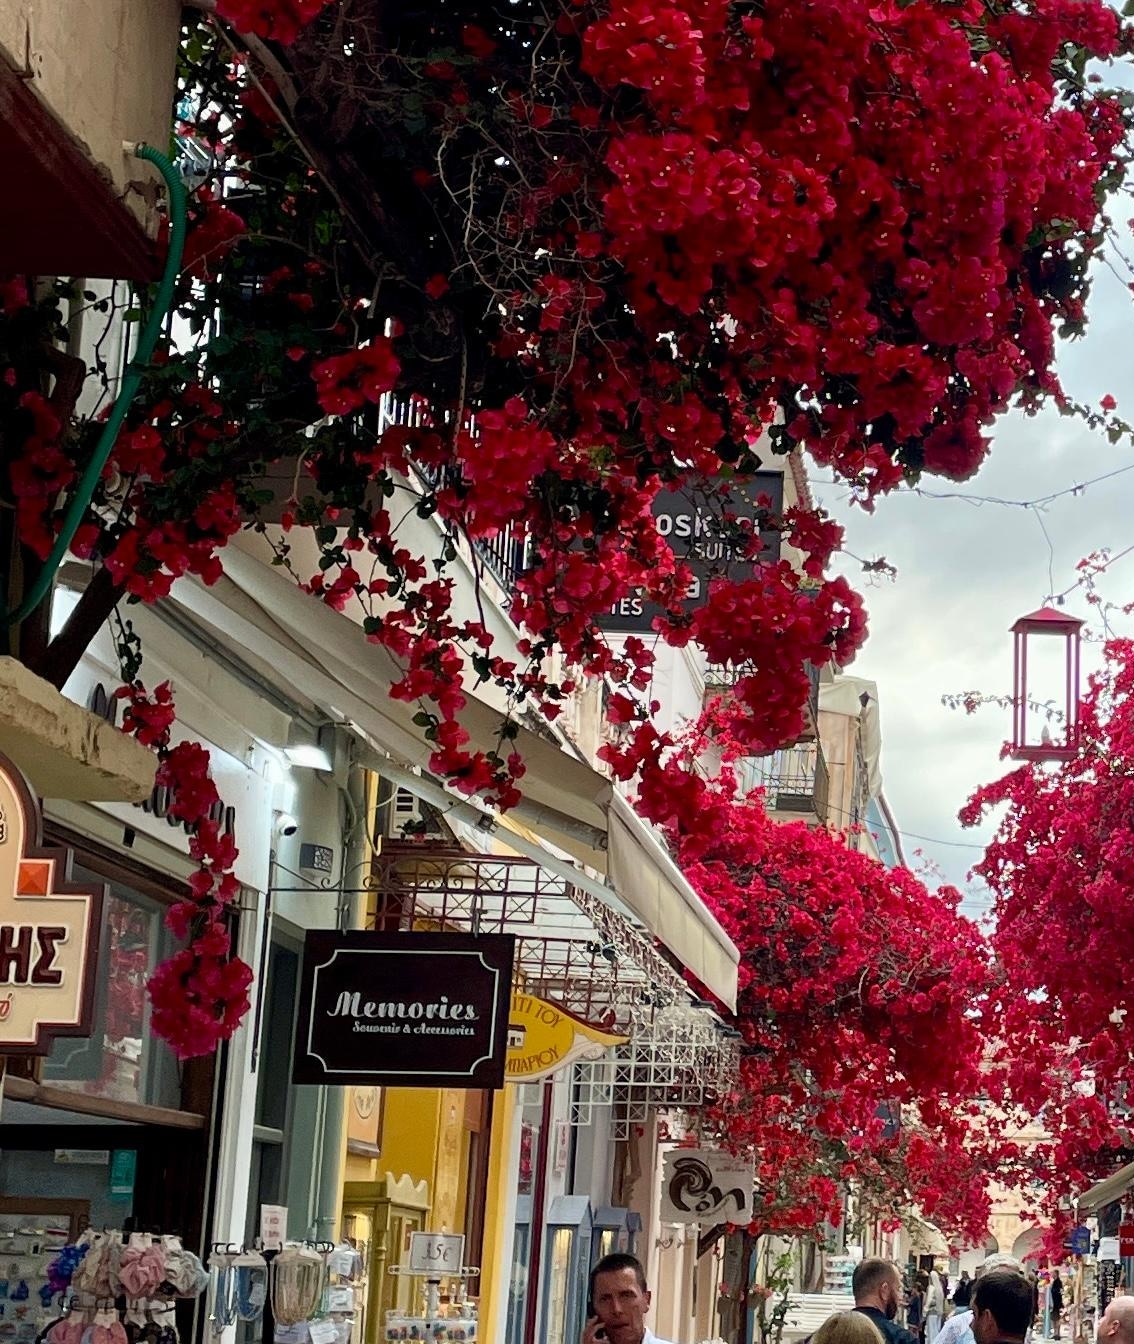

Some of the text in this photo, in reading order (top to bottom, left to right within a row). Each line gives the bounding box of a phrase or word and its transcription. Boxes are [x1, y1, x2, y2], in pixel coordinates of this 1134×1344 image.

[326, 990, 480, 1021] Memories
[534, 1004, 565, 1028] ΤΟΥ
[402, 1023, 411, 1034] &
[413, 1022, 476, 1036] Accessories
